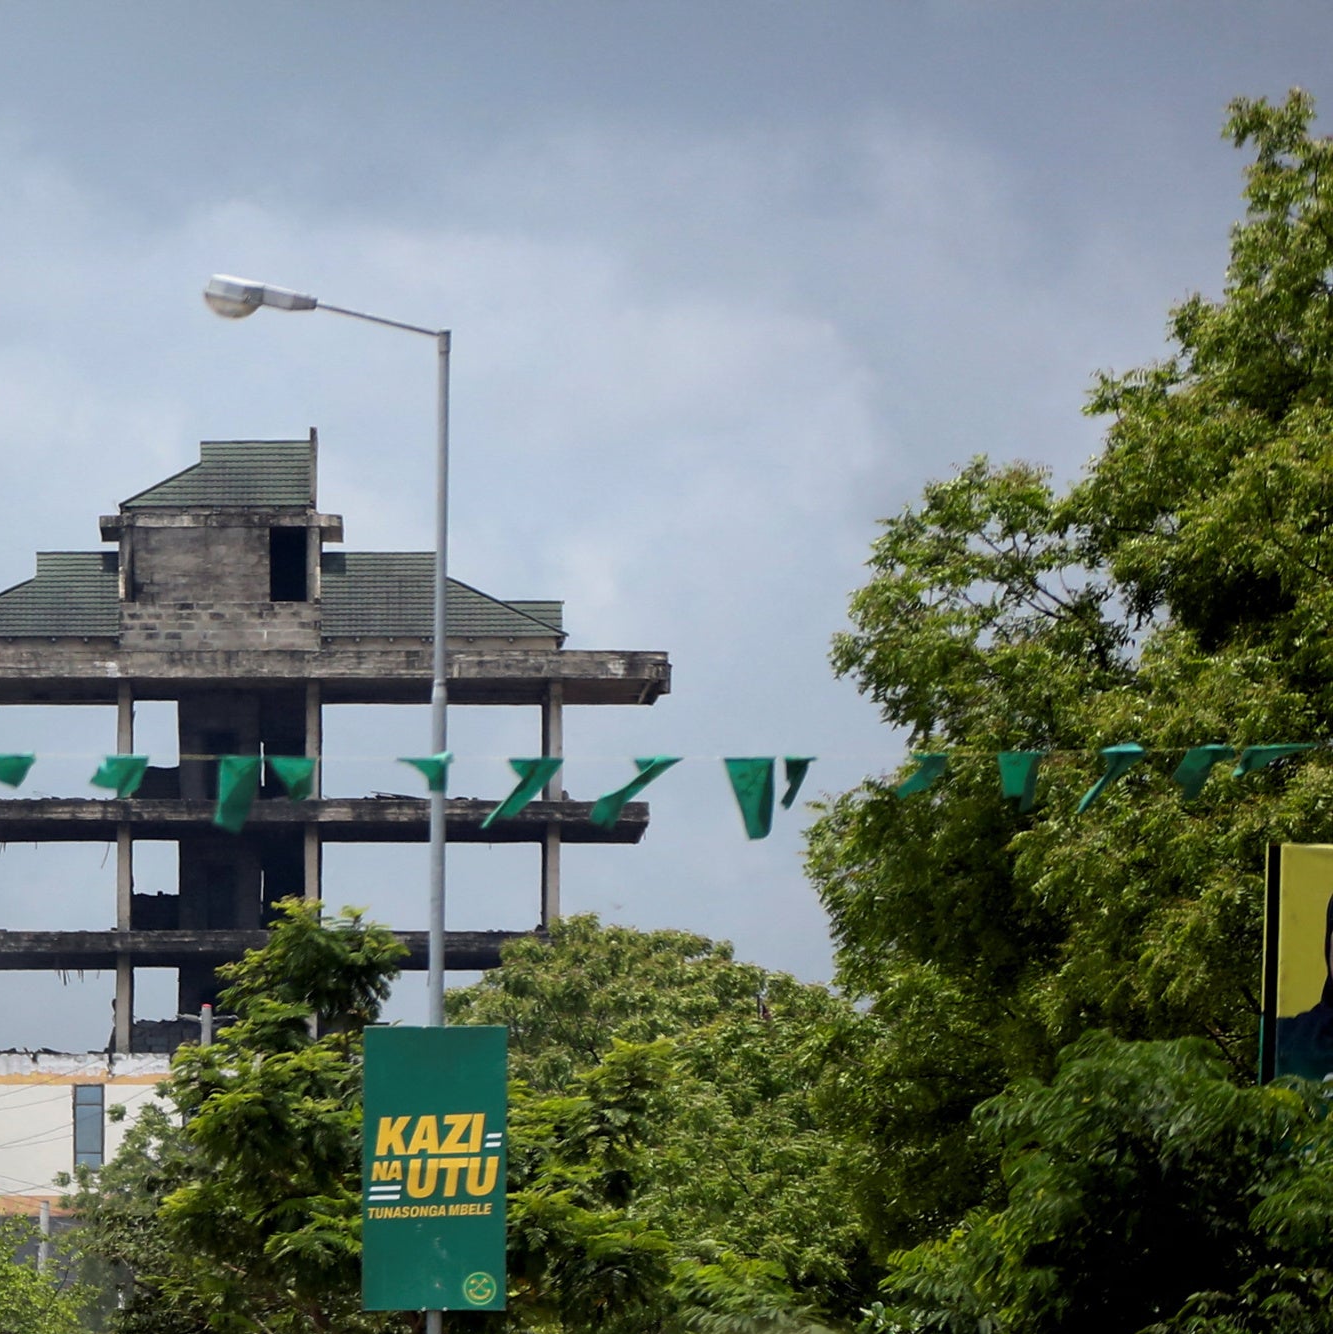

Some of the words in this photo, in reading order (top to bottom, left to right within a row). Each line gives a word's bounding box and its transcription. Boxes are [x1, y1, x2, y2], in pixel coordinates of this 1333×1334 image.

[374, 1112, 486, 1157] KAZI
[371, 1160, 403, 1182] NA
[406, 1156, 500, 1199] UTU
[367, 1204, 446, 1219] TUNASONGA
[448, 1202, 493, 1217] MBELE
